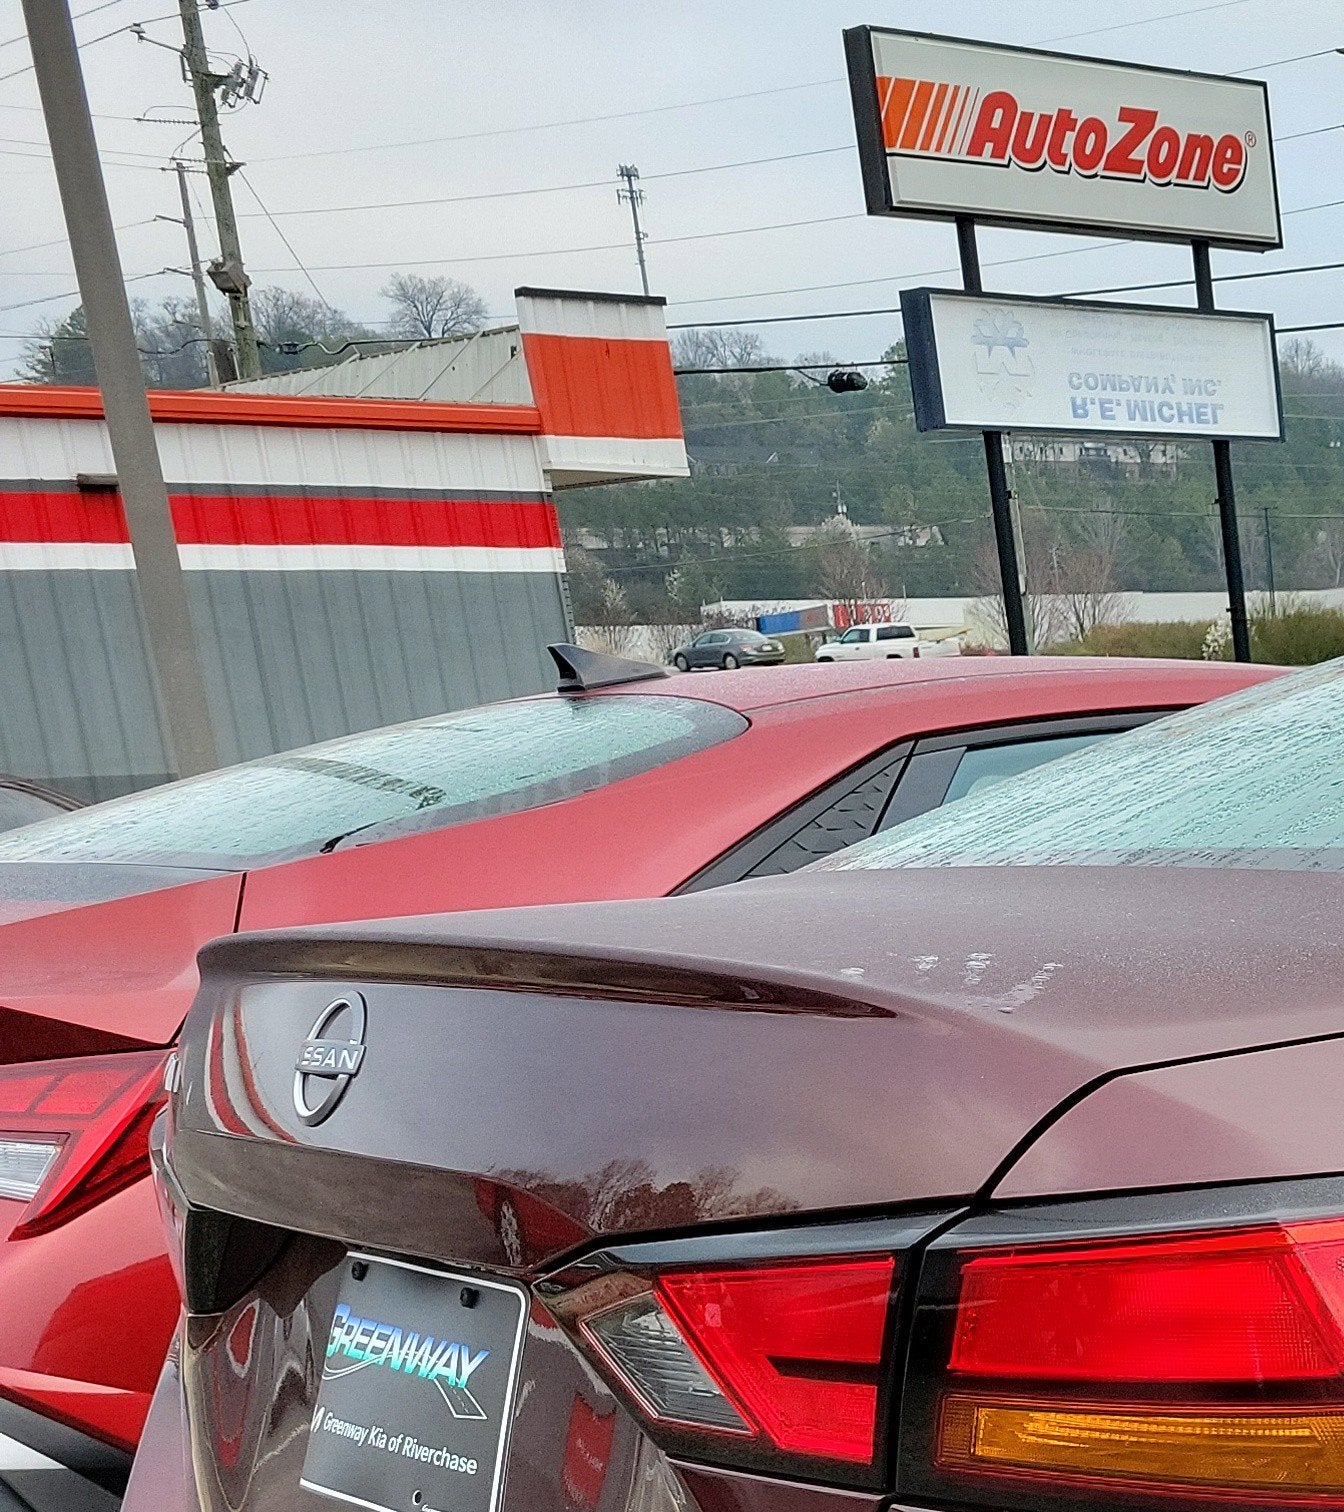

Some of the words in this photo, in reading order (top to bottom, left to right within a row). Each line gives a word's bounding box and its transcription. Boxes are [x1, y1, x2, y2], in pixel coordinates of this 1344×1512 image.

[966, 91, 1244, 188] AutoZone
[326, 1303, 490, 1389] GREENWAY
[323, 1411, 370, 1447] Greenway
[367, 1425, 388, 1449] Kia
[388, 1433, 404, 1454] of
[402, 1436, 478, 1475] Riverchase
